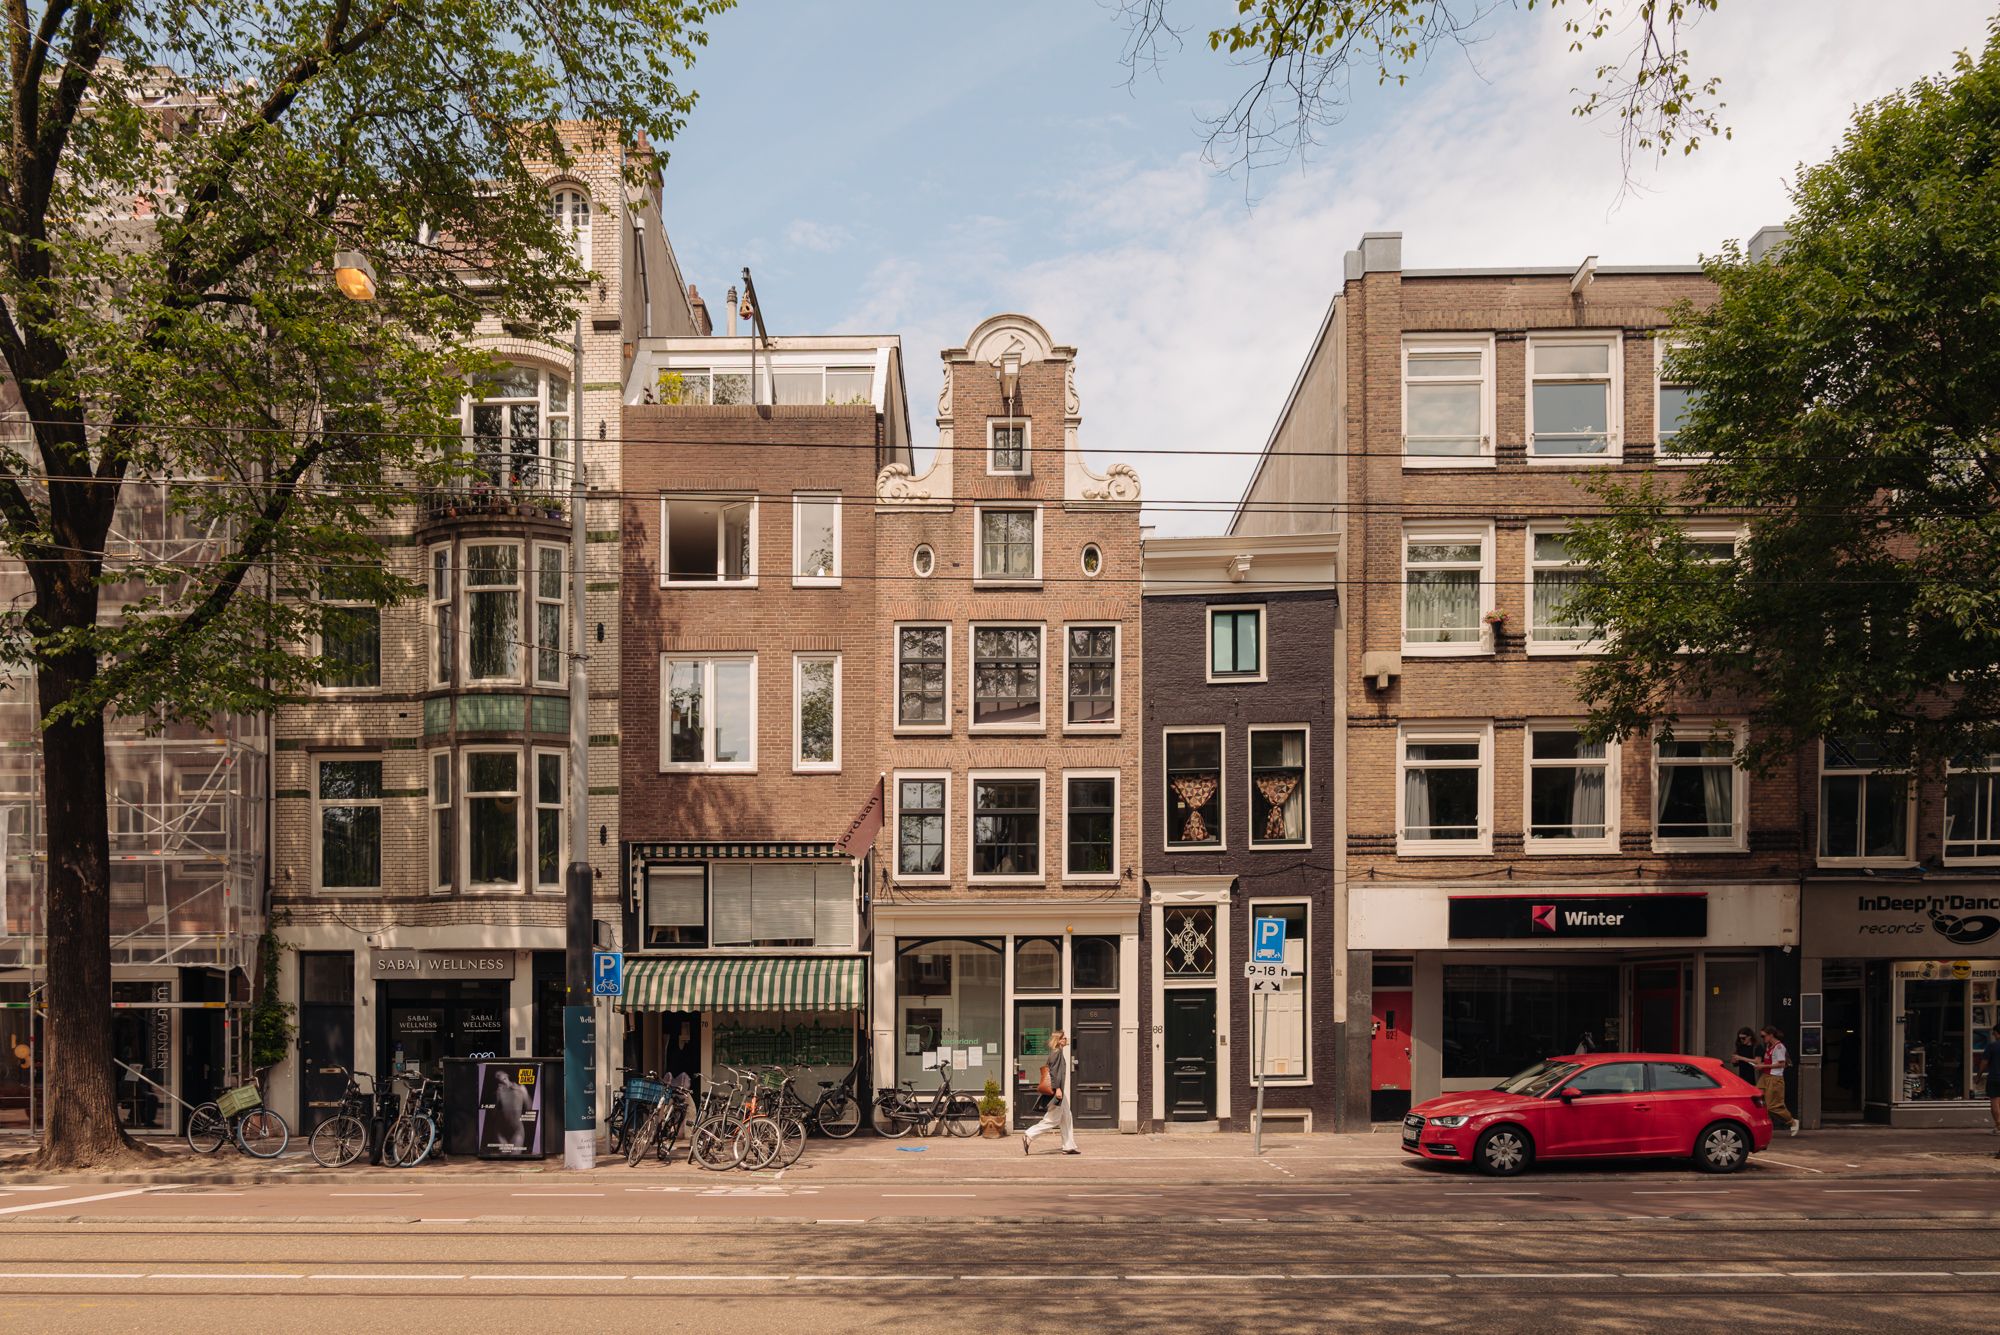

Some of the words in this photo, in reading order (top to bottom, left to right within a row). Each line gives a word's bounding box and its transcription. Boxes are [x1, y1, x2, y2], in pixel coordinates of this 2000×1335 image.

[837, 796, 879, 848] Jordaan
[1564, 911, 1624, 926] Winter
[1261, 922, 1279, 945] P
[1859, 921, 1925, 935] records
[378, 959, 421, 970] SABAI
[428, 959, 505, 970] WELLNESS
[600, 955, 615, 977] P
[1248, 966, 1276, 976] 9-18
[1281, 966, 1288, 976] h
[1783, 997, 1792, 1006] 62
